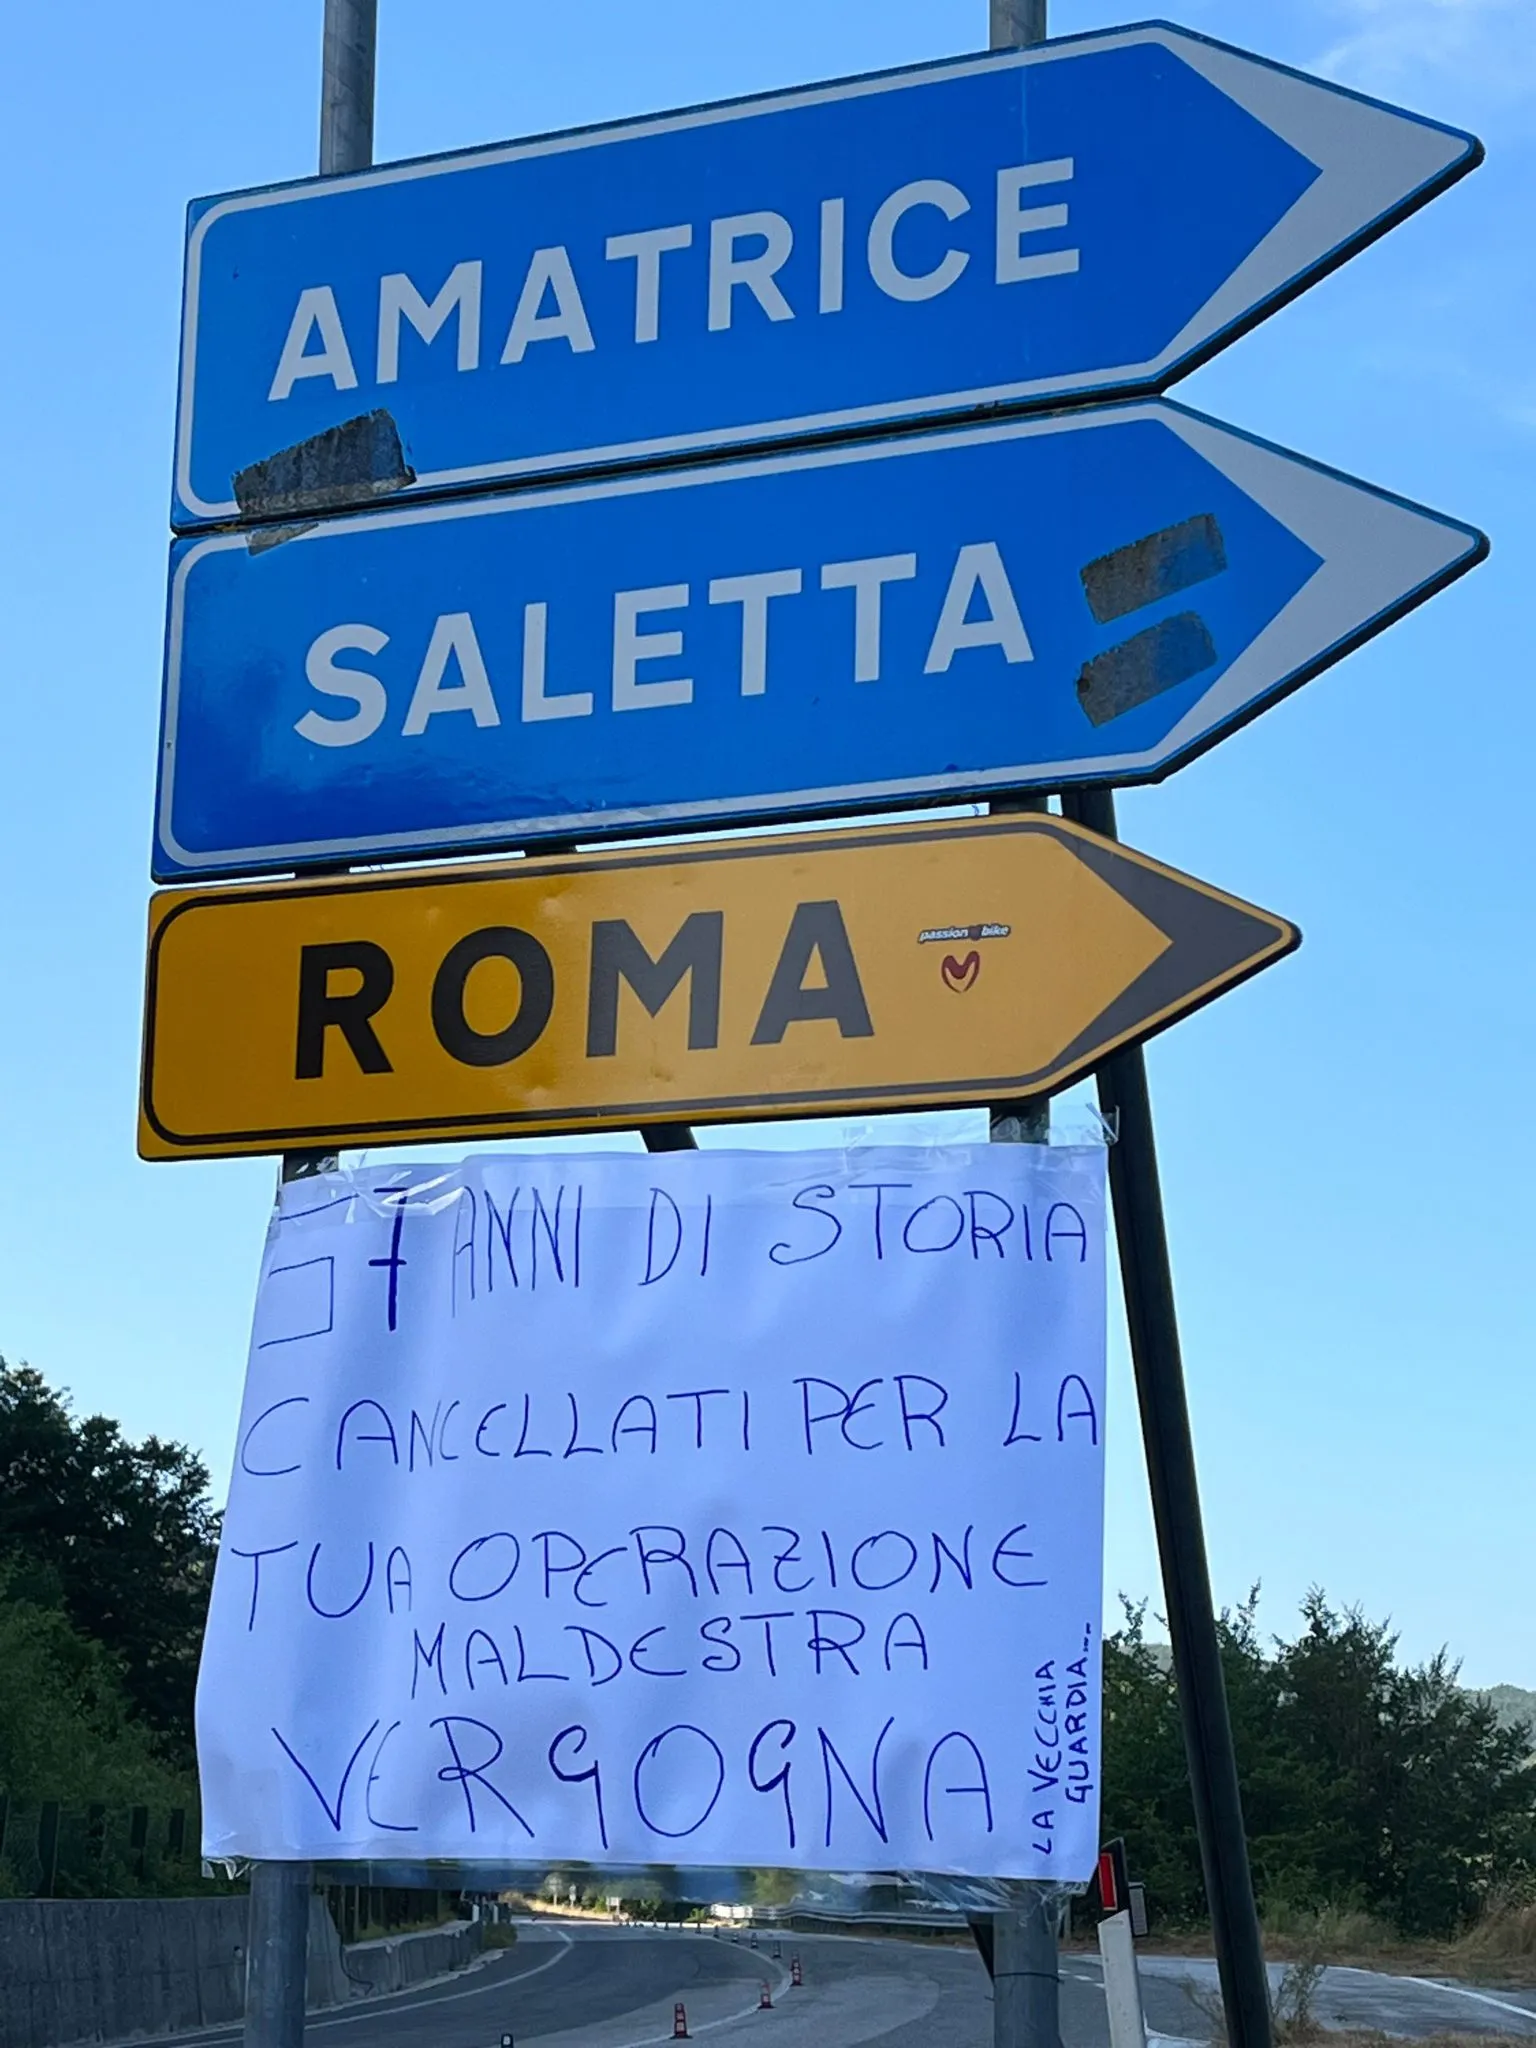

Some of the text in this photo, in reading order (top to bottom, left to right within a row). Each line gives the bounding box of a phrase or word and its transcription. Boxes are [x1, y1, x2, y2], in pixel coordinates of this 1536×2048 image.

[267, 157, 1081, 402] AMATRICE
[293, 540, 1034, 748] SALETTA
[295, 901, 873, 1080] ROMA
[920, 925, 1009, 942] passion bike
[452, 1184, 582, 1319] ANNI
[638, 1187, 712, 1286] DI
[769, 1183, 1088, 1266] STORIA
[241, 1371, 1098, 1477] CANCELLATI PER LA
[231, 1524, 1049, 1632] TUA OPERAZIONE
[411, 1610, 928, 1701] MALDESTRA
[272, 1717, 993, 1850] VERGOGNA
[1027, 1660, 1062, 1855] LA VECCHIA
